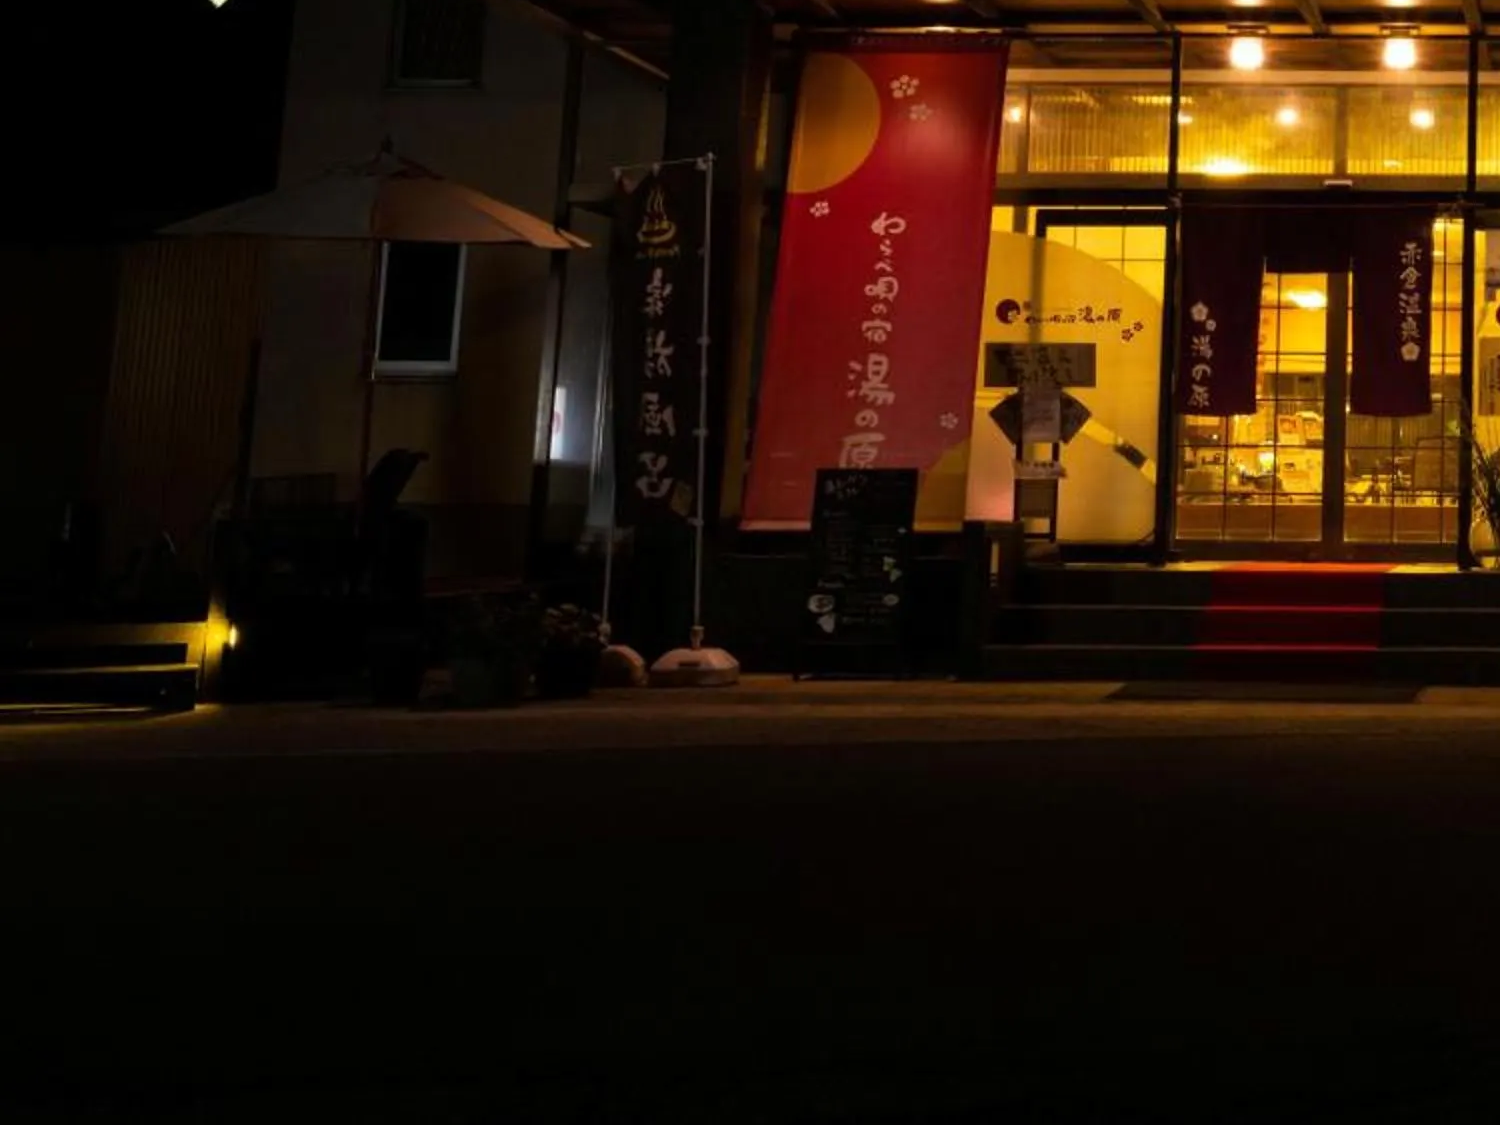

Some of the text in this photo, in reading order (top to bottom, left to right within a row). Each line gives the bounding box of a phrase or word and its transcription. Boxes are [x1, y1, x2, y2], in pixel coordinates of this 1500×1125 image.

[1399, 242, 1422, 340] 赤倉温泉
[1187, 335, 1213, 408] 湯の原
